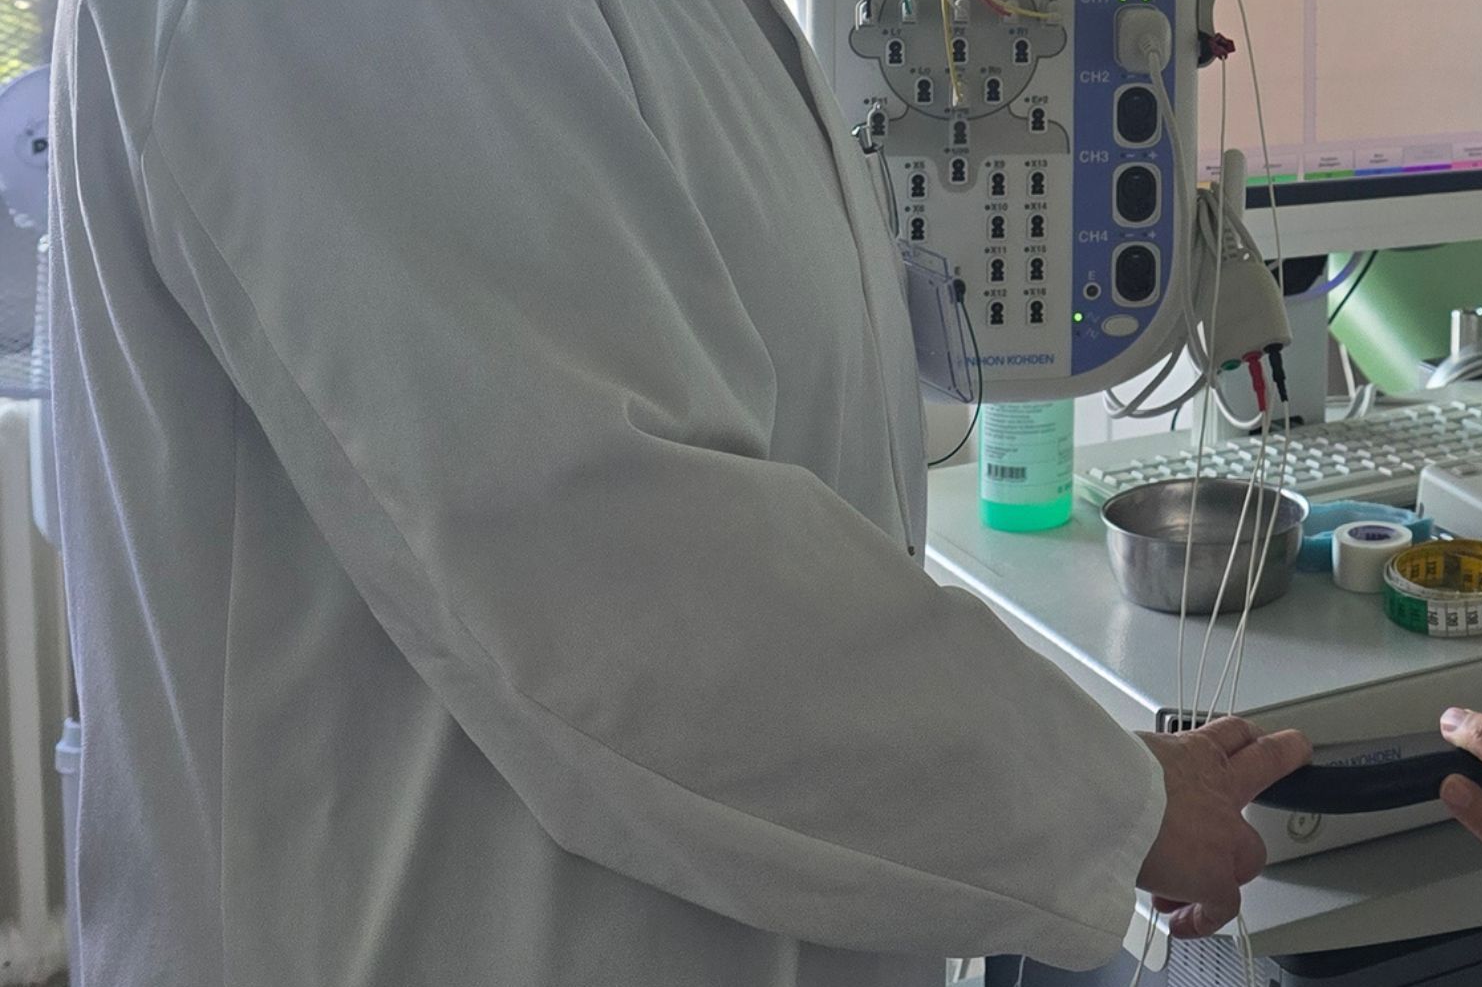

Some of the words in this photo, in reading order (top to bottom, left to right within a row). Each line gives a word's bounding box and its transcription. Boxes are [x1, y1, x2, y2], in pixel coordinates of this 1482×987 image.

[1079, 71, 1110, 83] CH2
[1079, 150, 1109, 163] CH3
[1030, 160, 1048, 168] X13
[990, 203, 1008, 212] X10
[1030, 202, 1047, 211] X14
[1078, 230, 1108, 243] CH4
[990, 245, 1007, 254] X11
[1088, 270, 1096, 281] E
[990, 289, 1007, 298] X12
[1006, 353, 1055, 365] KOHDEN
